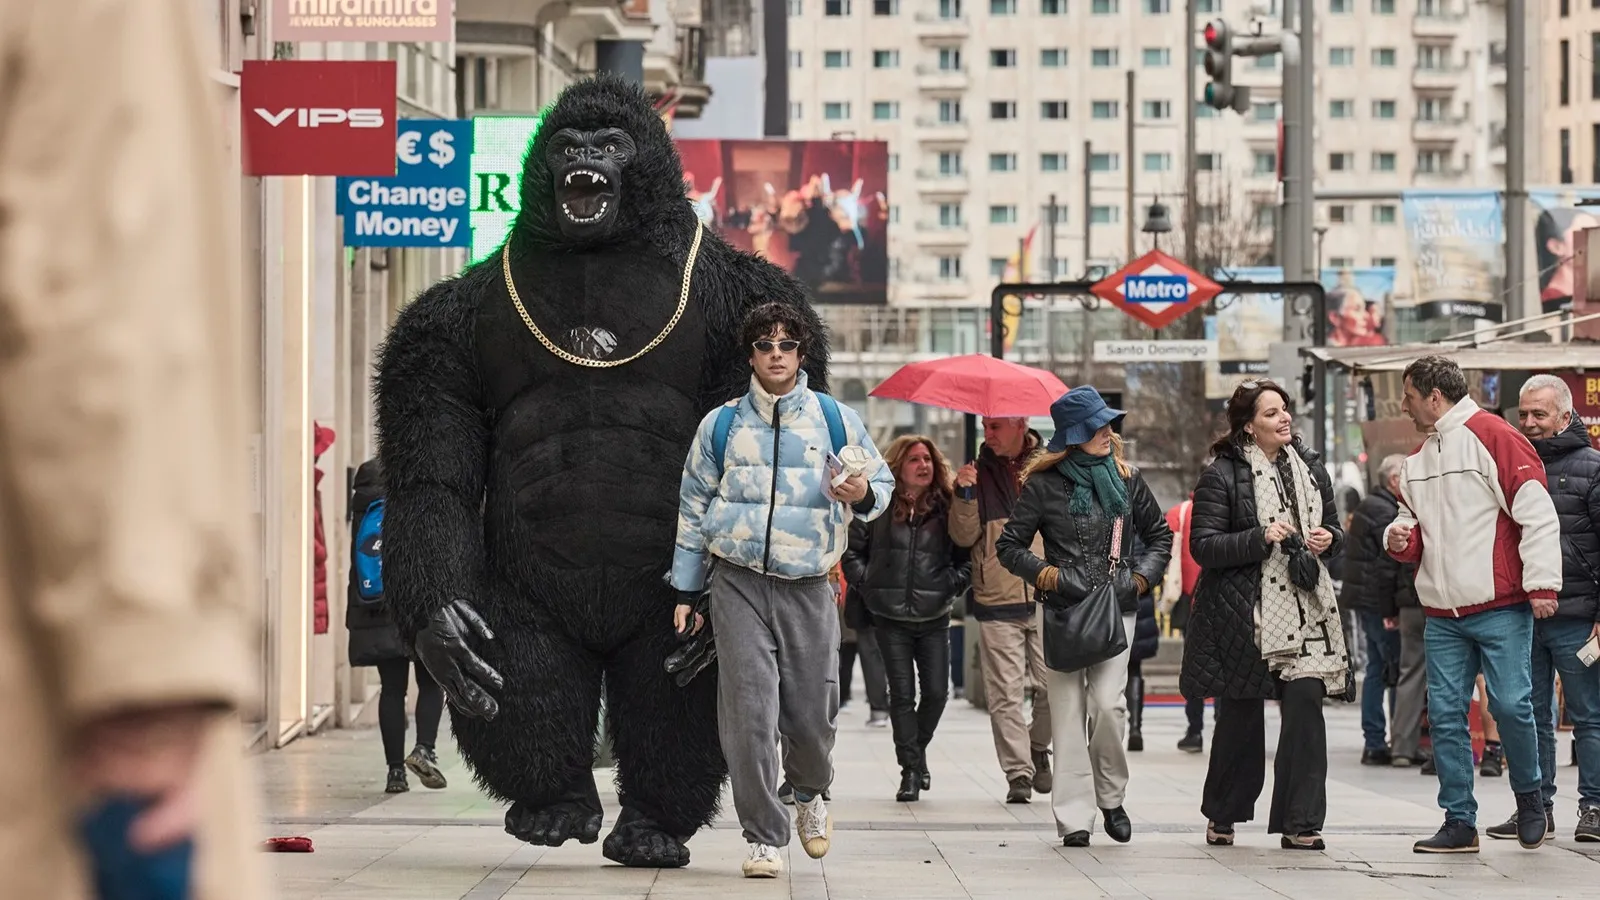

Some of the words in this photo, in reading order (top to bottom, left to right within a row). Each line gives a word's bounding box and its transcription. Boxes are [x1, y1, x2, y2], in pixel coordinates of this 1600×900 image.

[289, 17, 341, 27] JEWELRY
[343, 17, 353, 27] &
[356, 17, 437, 27] SUNGLASSES
[253, 108, 385, 128] VIPS
[348, 180, 467, 212] Change
[355, 211, 459, 243] Money
[1127, 280, 1186, 299] Metro
[1106, 344, 1144, 356] Santo
[1148, 344, 1208, 357] Domingo
